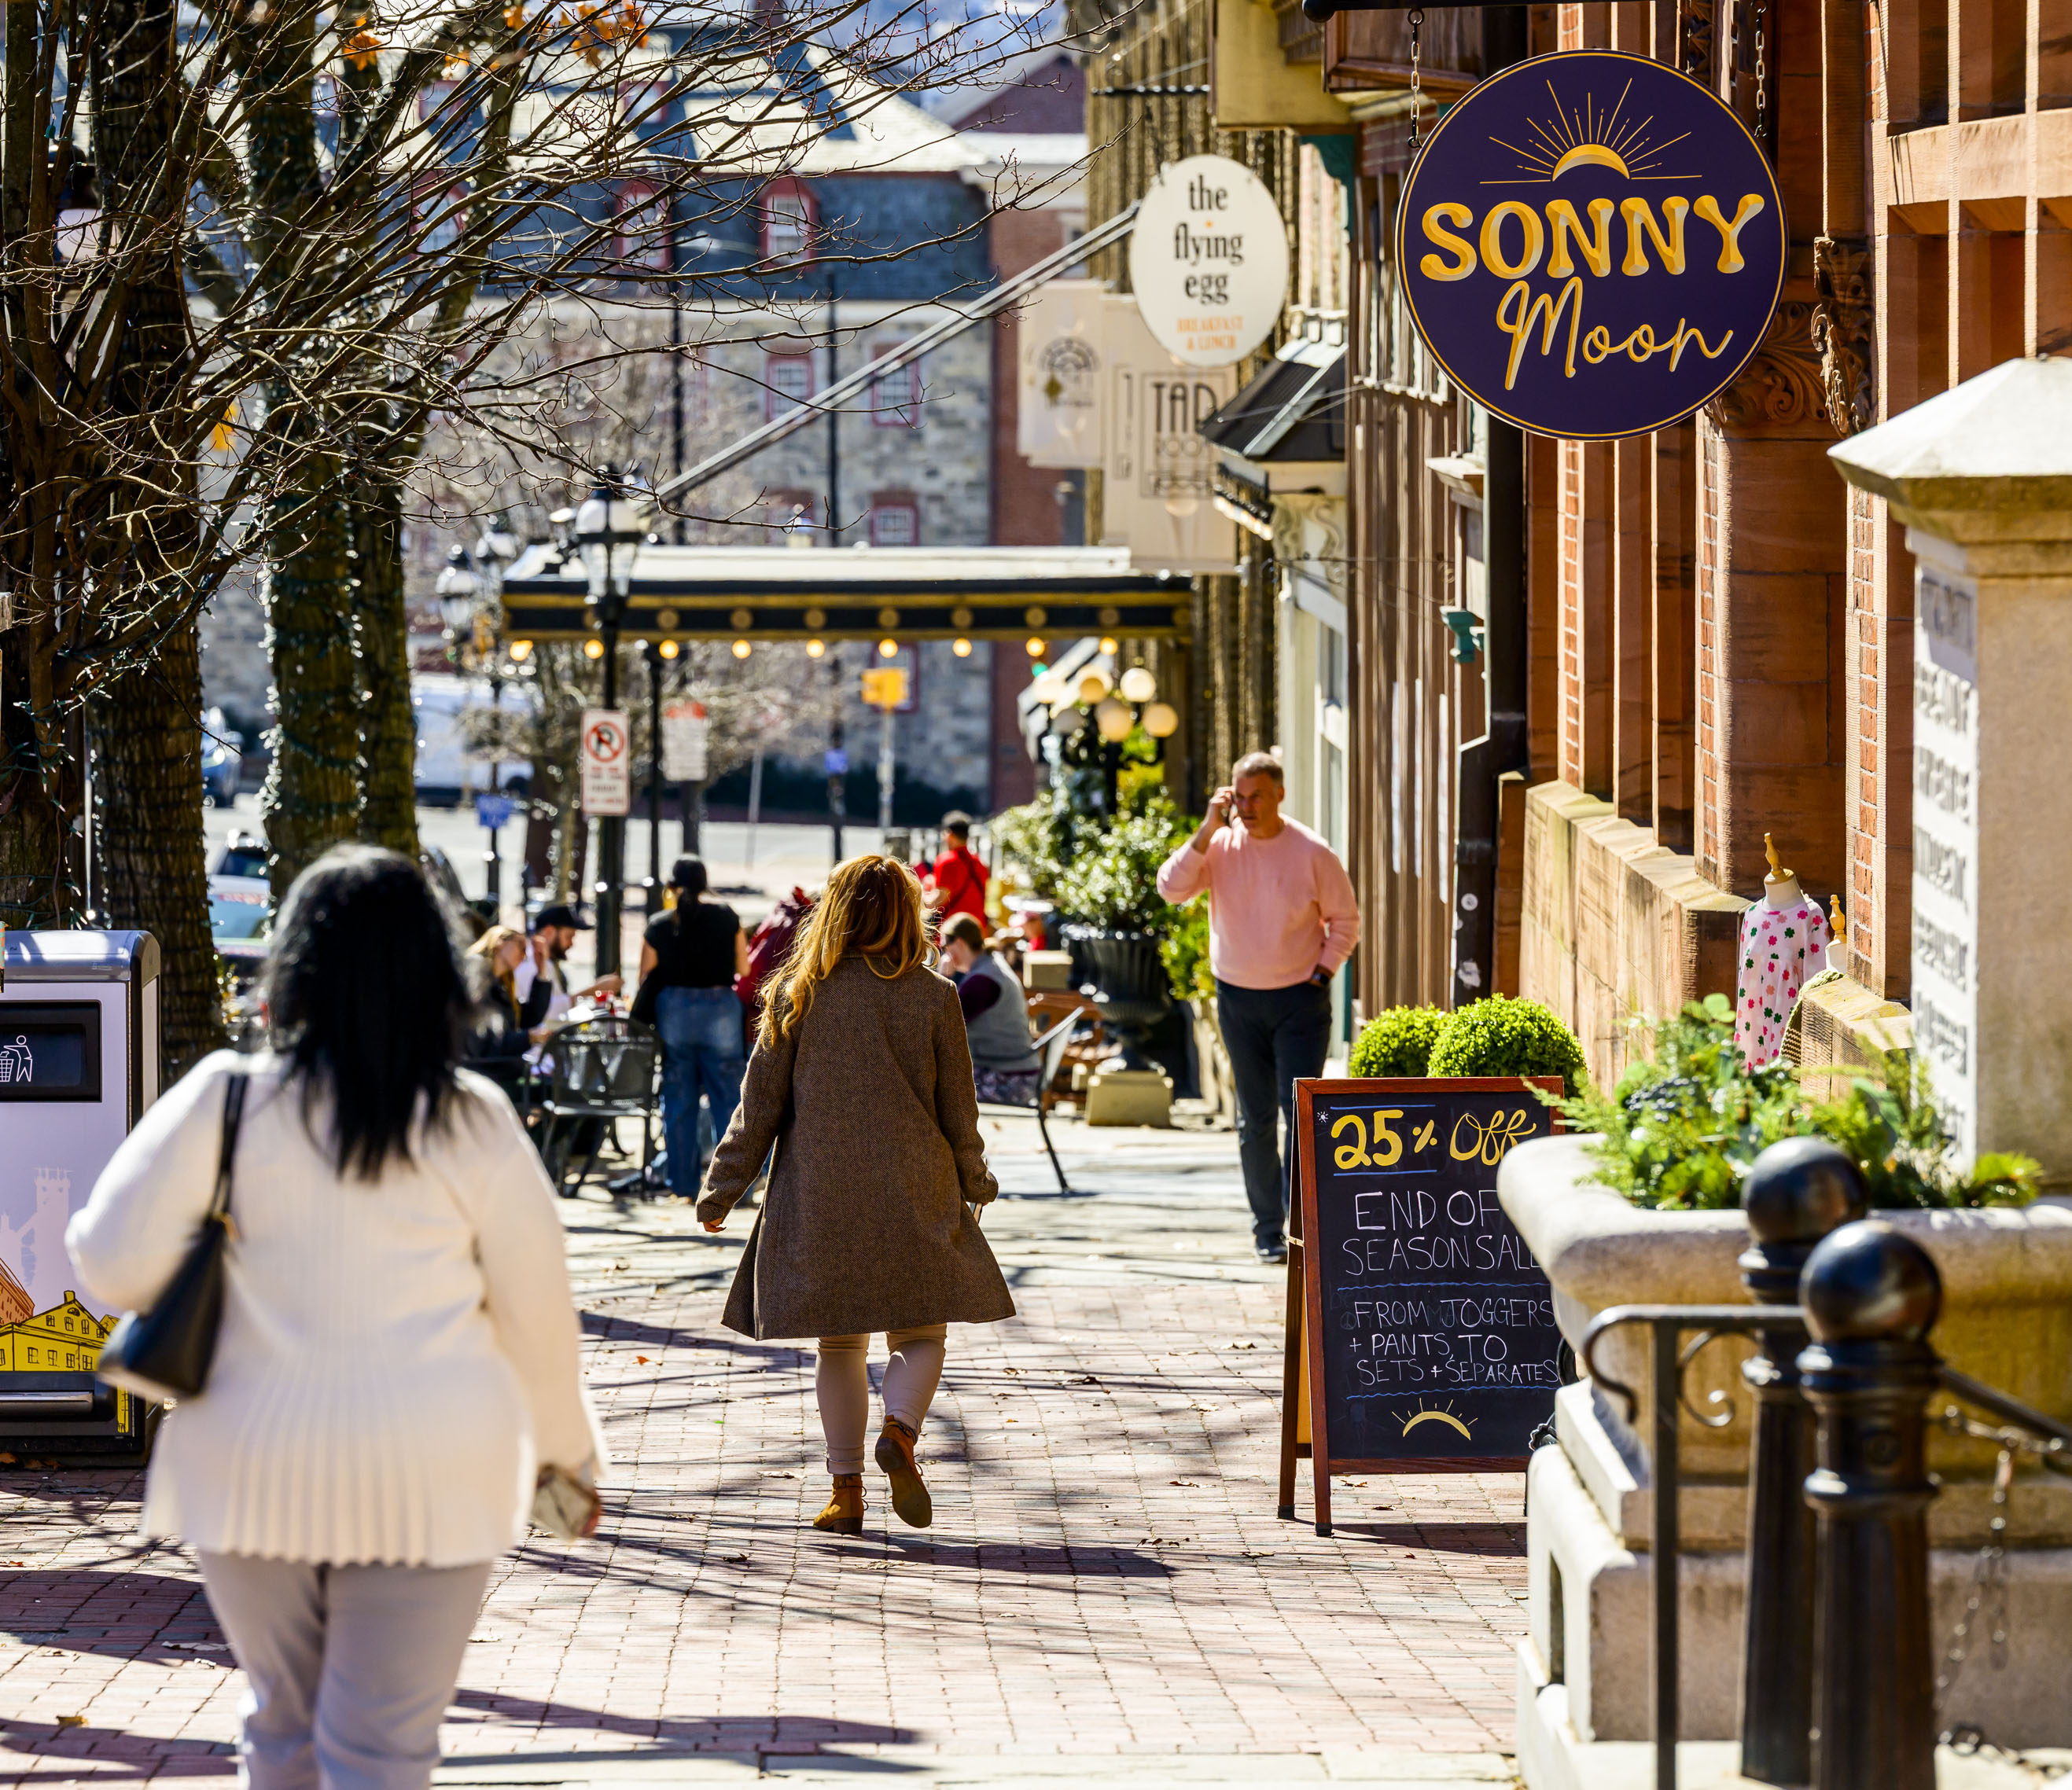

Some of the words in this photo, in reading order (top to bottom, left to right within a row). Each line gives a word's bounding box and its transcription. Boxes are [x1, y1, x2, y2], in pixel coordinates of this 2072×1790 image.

[1188, 174, 1228, 211] the
[1174, 222, 1245, 266] flying
[1419, 194, 1765, 281] SONNY
[1185, 274, 1230, 305] egg
[1496, 276, 1733, 391] Moon
[1449, 1109, 1537, 1166] Off
[1355, 1190, 1437, 1230] END
[1447, 1189, 1500, 1226] OF
[1342, 1235, 1470, 1275] SEASON
[1354, 1300, 1430, 1328] FROM
[1440, 1298, 1557, 1328] JOGGERS
[1349, 1337, 1362, 1352] +
[1457, 1334, 1507, 1362] TO
[1356, 1359, 1424, 1385] SETS
[1445, 1359, 1559, 1384] SEPARATES
